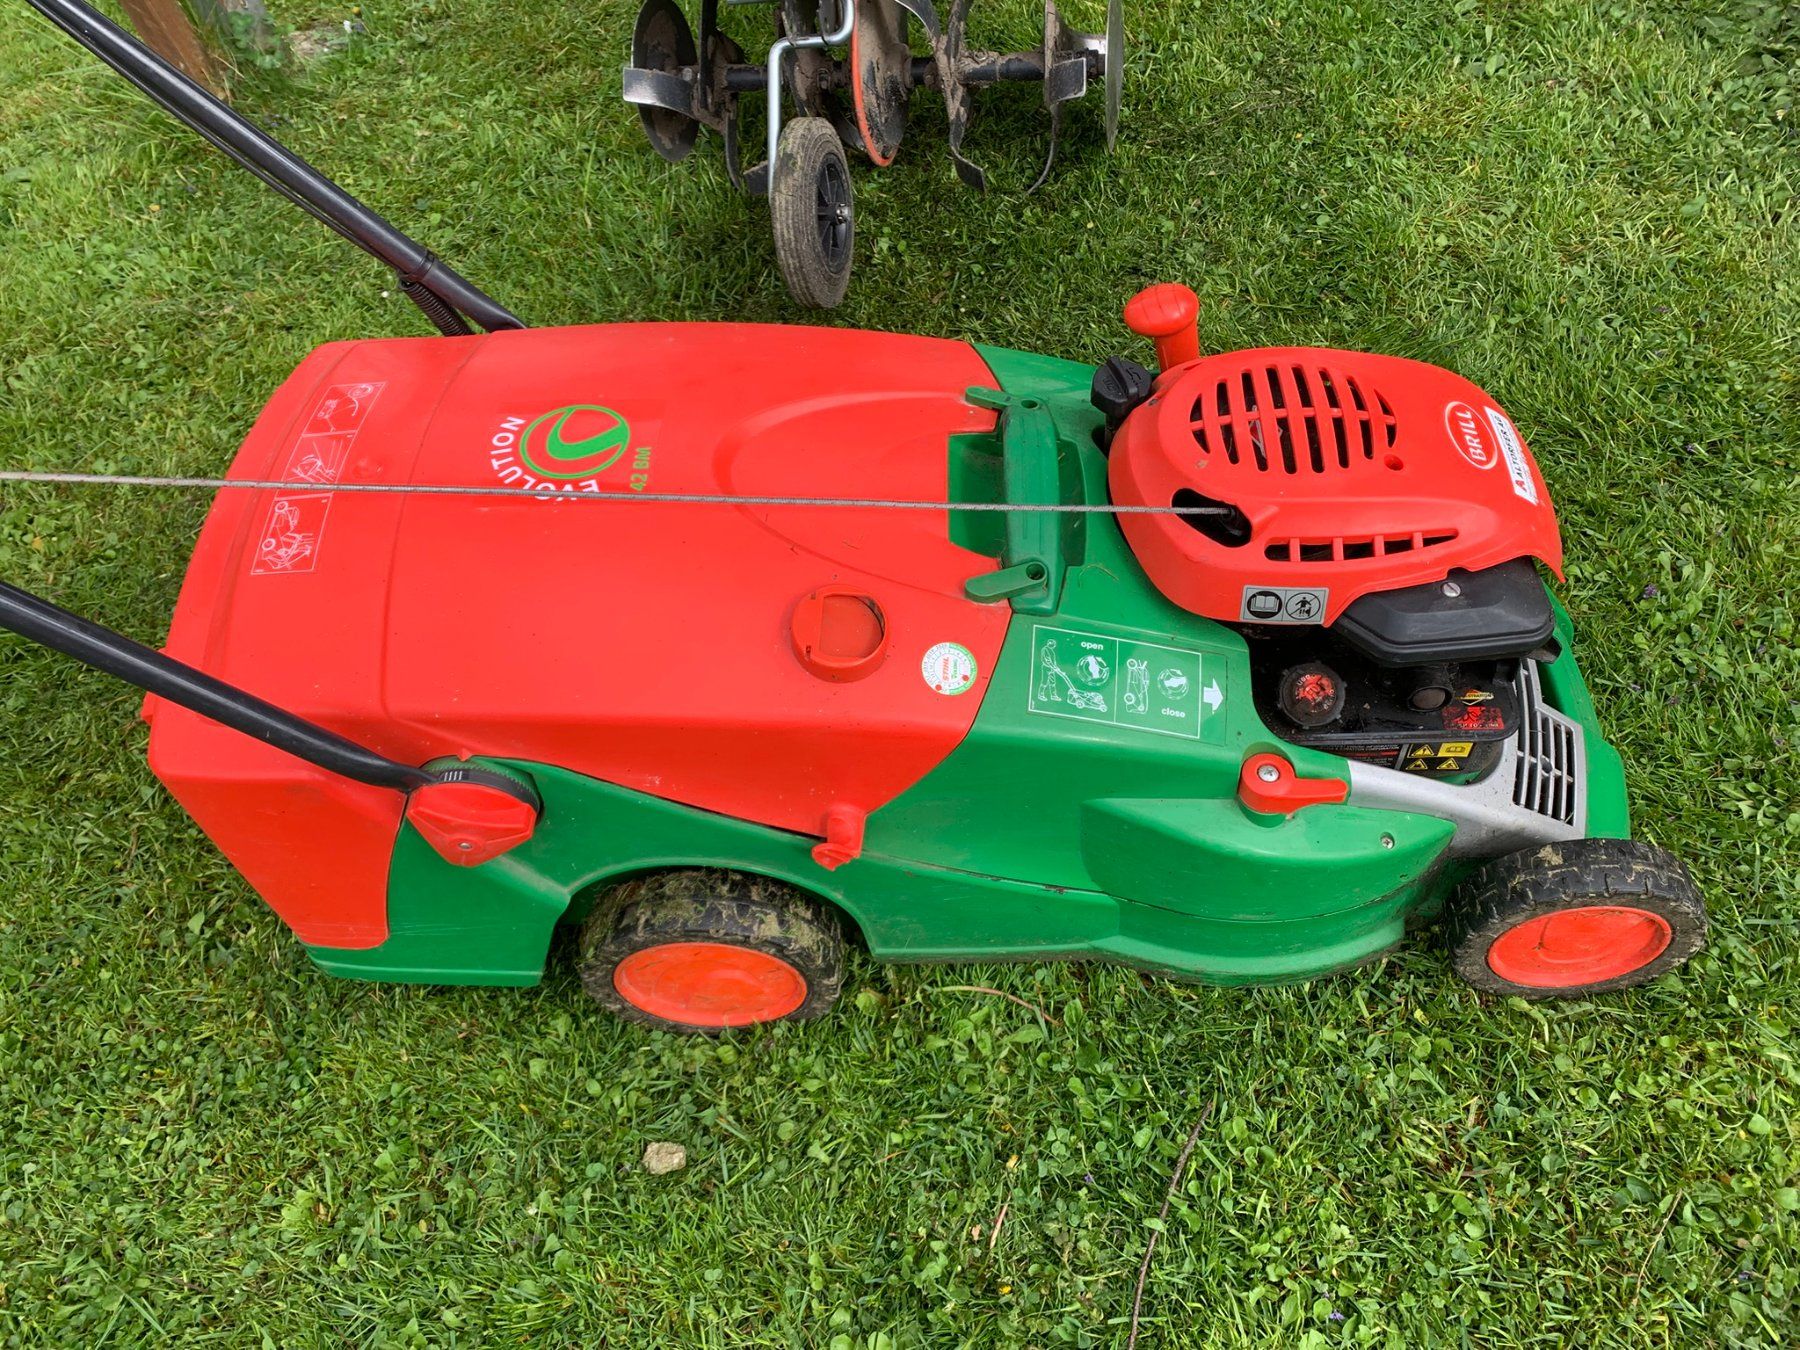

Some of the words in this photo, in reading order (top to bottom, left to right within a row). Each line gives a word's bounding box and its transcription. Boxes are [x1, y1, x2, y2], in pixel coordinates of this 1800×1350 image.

[1455, 410, 1487, 461] BRILL
[1501, 428, 1524, 479] ALTORFER
[629, 473, 648, 491] 42
[1081, 640, 1104, 651] open
[1161, 706, 1186, 719] close
